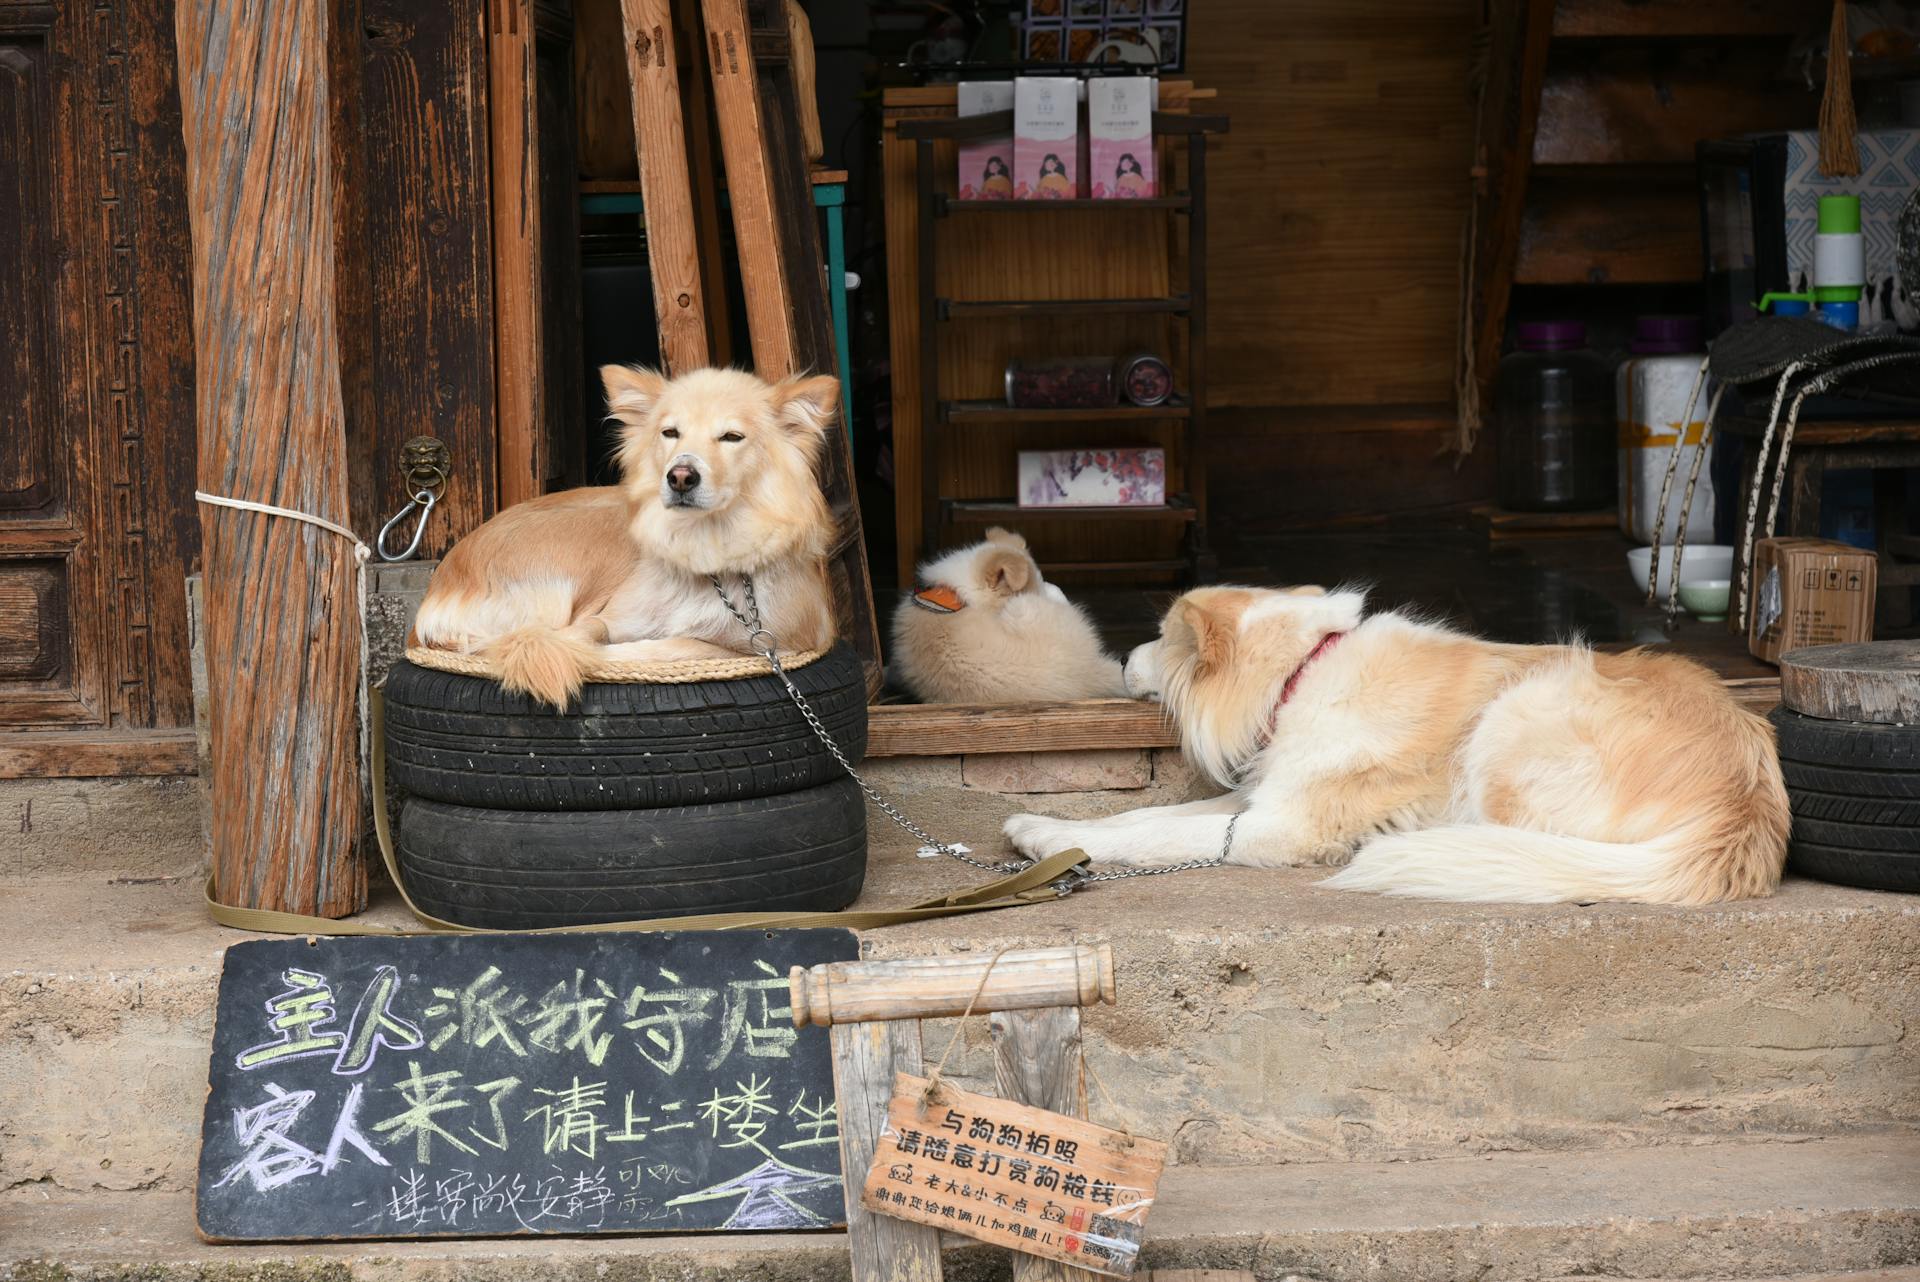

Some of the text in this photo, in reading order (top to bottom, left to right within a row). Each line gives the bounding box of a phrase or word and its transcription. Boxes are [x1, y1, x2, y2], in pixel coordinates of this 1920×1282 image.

[236, 959, 799, 1075] 主人派我守店
[896, 1127, 1116, 1207] 请随意打赏狗粮钱
[941, 1109, 1079, 1165] 与狗狗拍照
